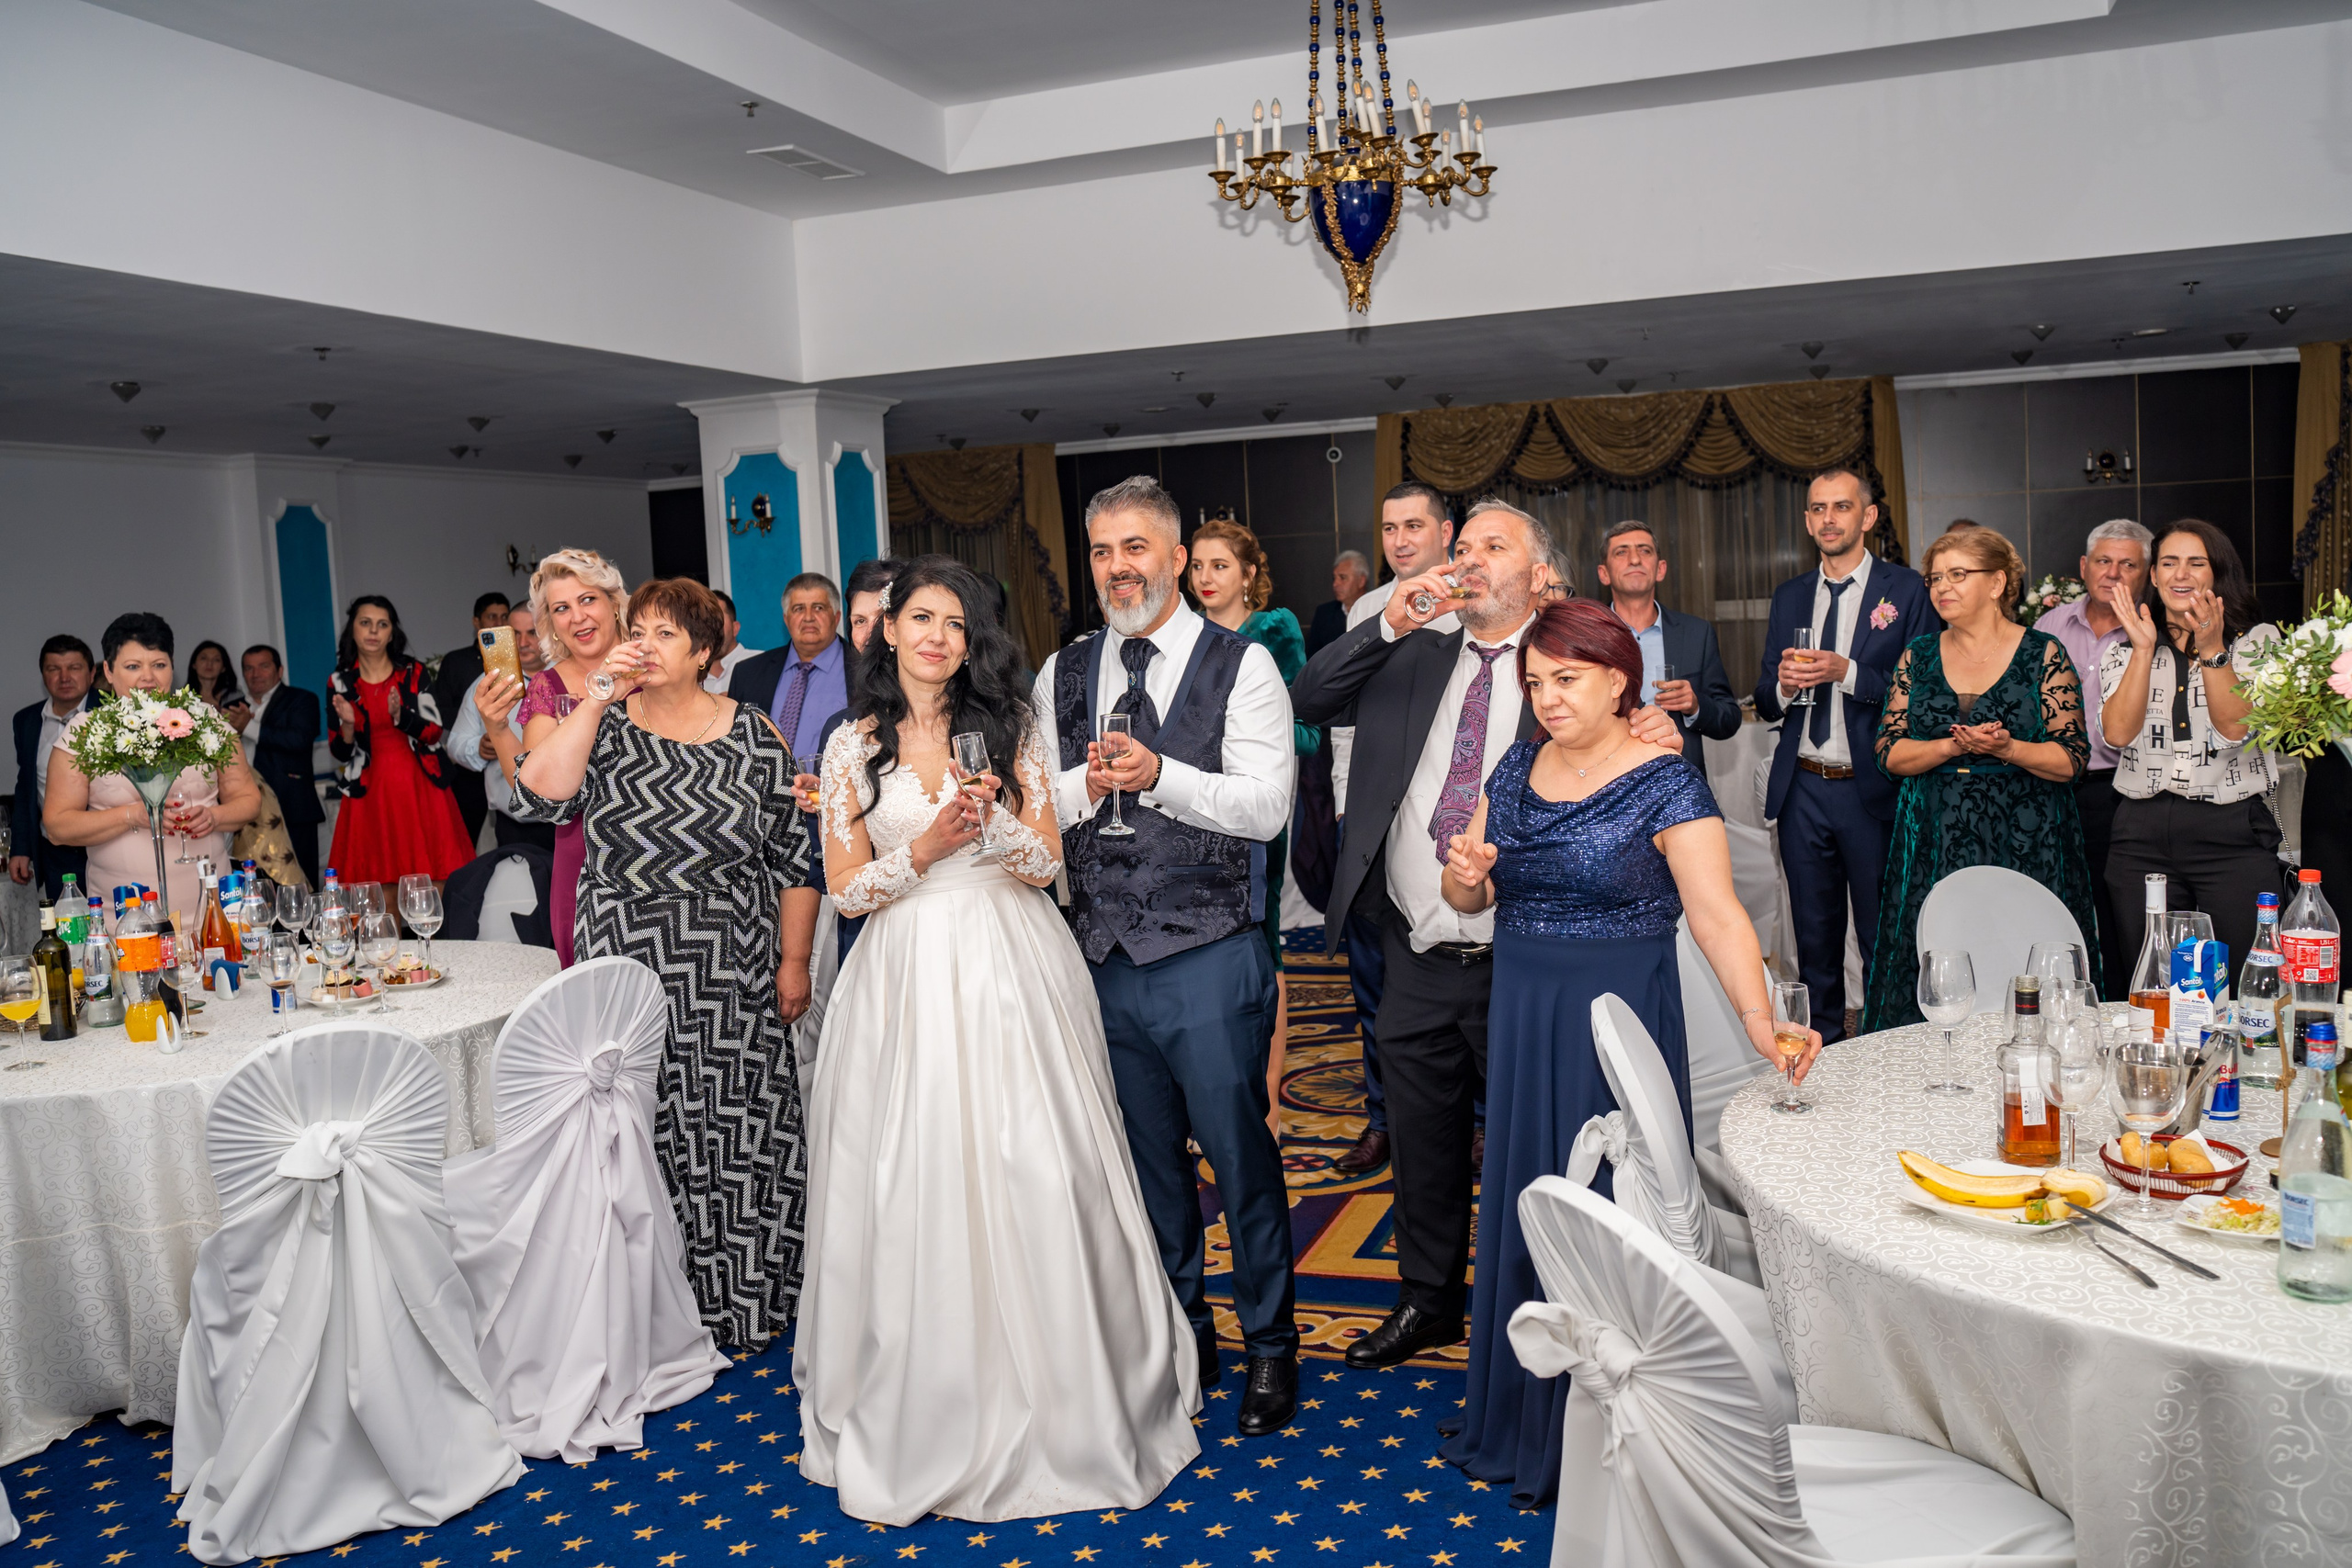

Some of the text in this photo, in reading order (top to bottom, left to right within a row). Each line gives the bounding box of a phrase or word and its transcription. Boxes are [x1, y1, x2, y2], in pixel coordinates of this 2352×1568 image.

[2151, 688, 2164, 703] E
[220, 887, 242, 900] Santal
[2181, 976, 2201, 987] Santal
[2240, 1014, 2270, 1028] ORSEC
[2220, 1063, 2238, 1074] Bull
